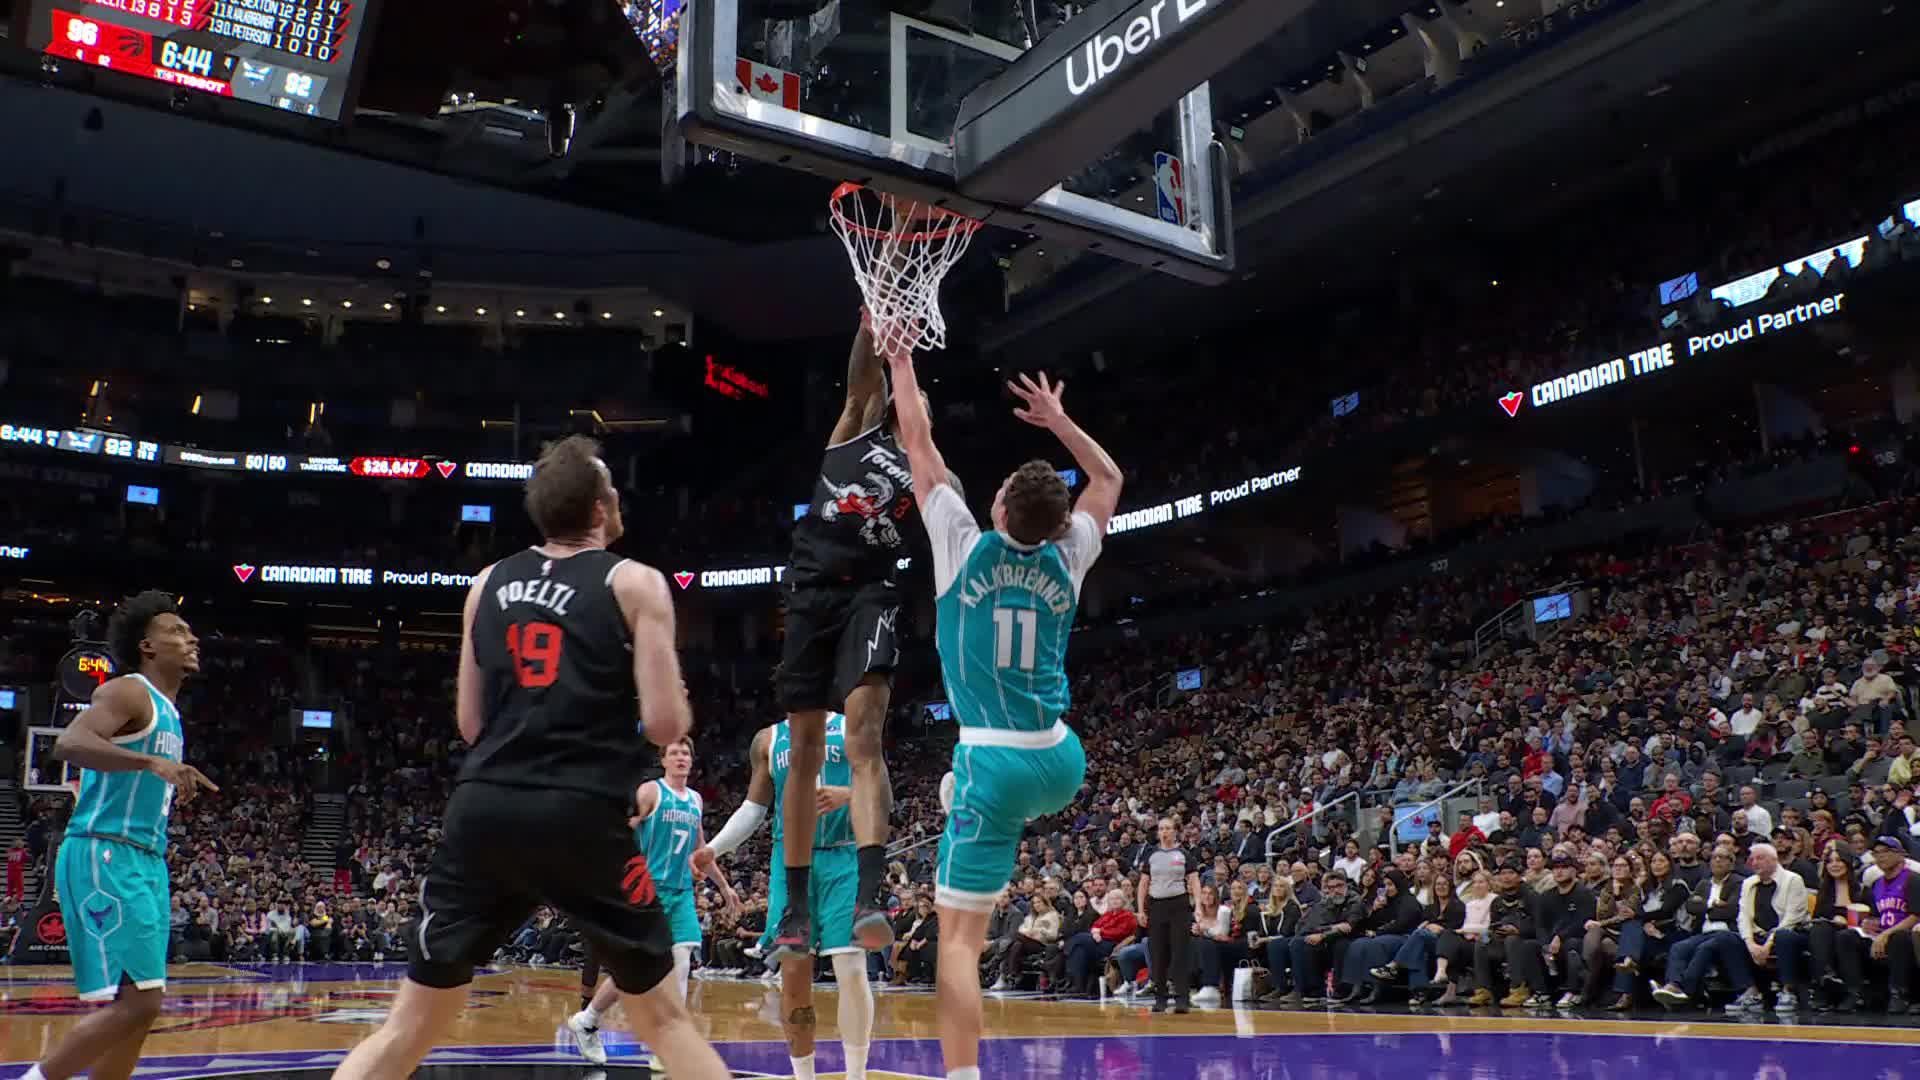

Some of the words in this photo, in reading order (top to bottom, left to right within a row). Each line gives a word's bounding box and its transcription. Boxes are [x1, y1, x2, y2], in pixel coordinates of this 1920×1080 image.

[148, 3, 160, 17] 8
[165, 7, 174, 22] 1
[180, 10, 192, 26] 3
[278, 3, 294, 19] 12
[295, 8, 307, 22] 2
[311, 11, 323, 26] 2
[326, 15, 335, 30] 1
[67, 18, 98, 46] 96
[278, 18, 288, 33] 7
[290, 21, 306, 38] 10
[307, 26, 319, 42] 0
[322, 30, 331, 45] 1
[162, 40, 213, 76] 6:44
[274, 33, 282, 49] 1
[288, 38, 300, 53] 0
[304, 42, 313, 57] 1
[318, 46, 330, 61] 0
[1065, 0, 1166, 96] Uber
[284, 72, 313, 98] 92
[1531, 357, 1626, 408] CANADIAN
[1629, 342, 1675, 376] TIRE
[1688, 319, 1753, 357] Proud
[1757, 292, 1845, 335] Partner
[465, 461, 534, 479] CANADIAN
[1106, 502, 1174, 535] CANADIAN
[1174, 493, 1203, 519] TIRE
[1209, 480, 1250, 507] Proud
[1251, 465, 1302, 494] Partner
[261, 565, 337, 584] CANADIAN
[340, 567, 374, 585] TIRE
[383, 570, 429, 586] Proud
[431, 571, 479, 587] Partne
[701, 566, 772, 588] CANADIAN
[496, 579, 576, 617] POELTL
[992, 607, 1038, 671] 11
[78, 657, 109, 673] 6:44
[504, 620, 564, 689] 19
[672, 829, 689, 855] 7
